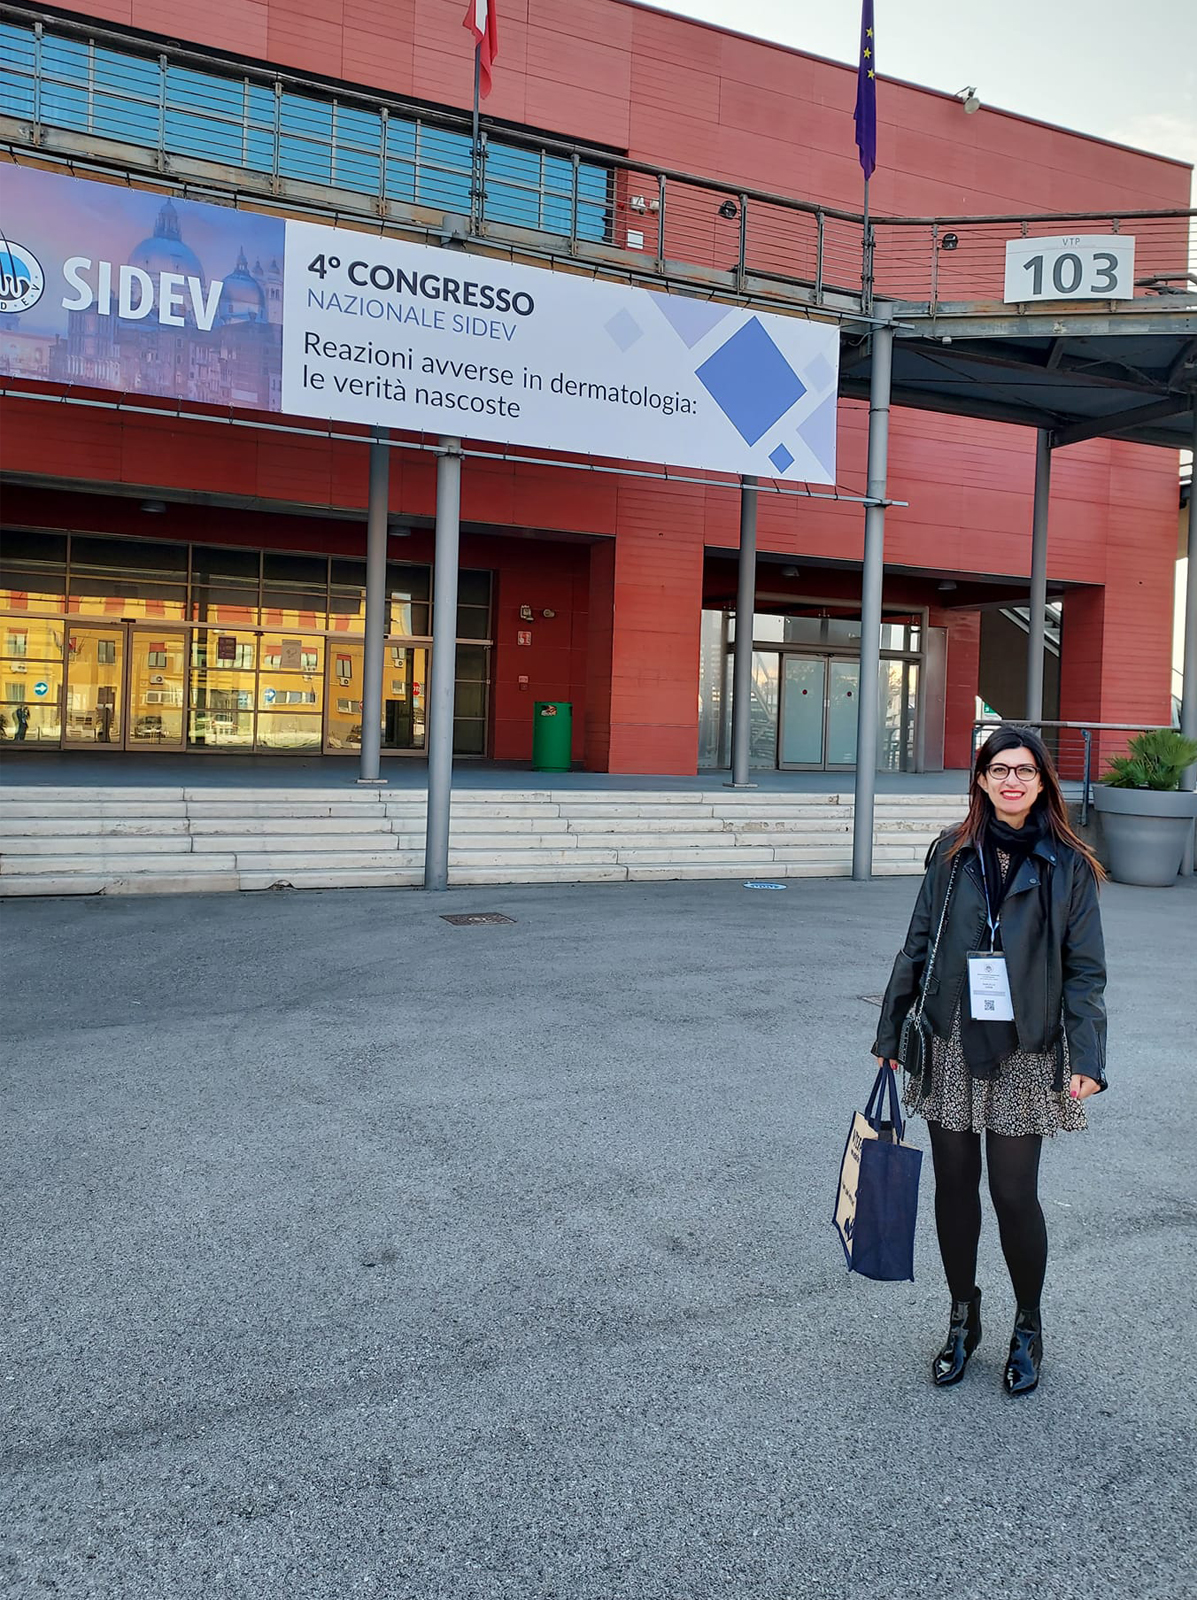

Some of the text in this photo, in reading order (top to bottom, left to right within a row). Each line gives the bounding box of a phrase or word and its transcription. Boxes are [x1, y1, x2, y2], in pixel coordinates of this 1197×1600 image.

[1062, 237, 1081, 247] VTP
[61, 256, 224, 331] SIDEV
[347, 260, 535, 316] CONGRESSO
[1023, 252, 1119, 295] 103
[307, 288, 517, 341] NAZIONALE SIDEV
[303, 364, 520, 418] le verità nascoste
[304, 331, 697, 415] Reazioni avverse in dermatologia:
